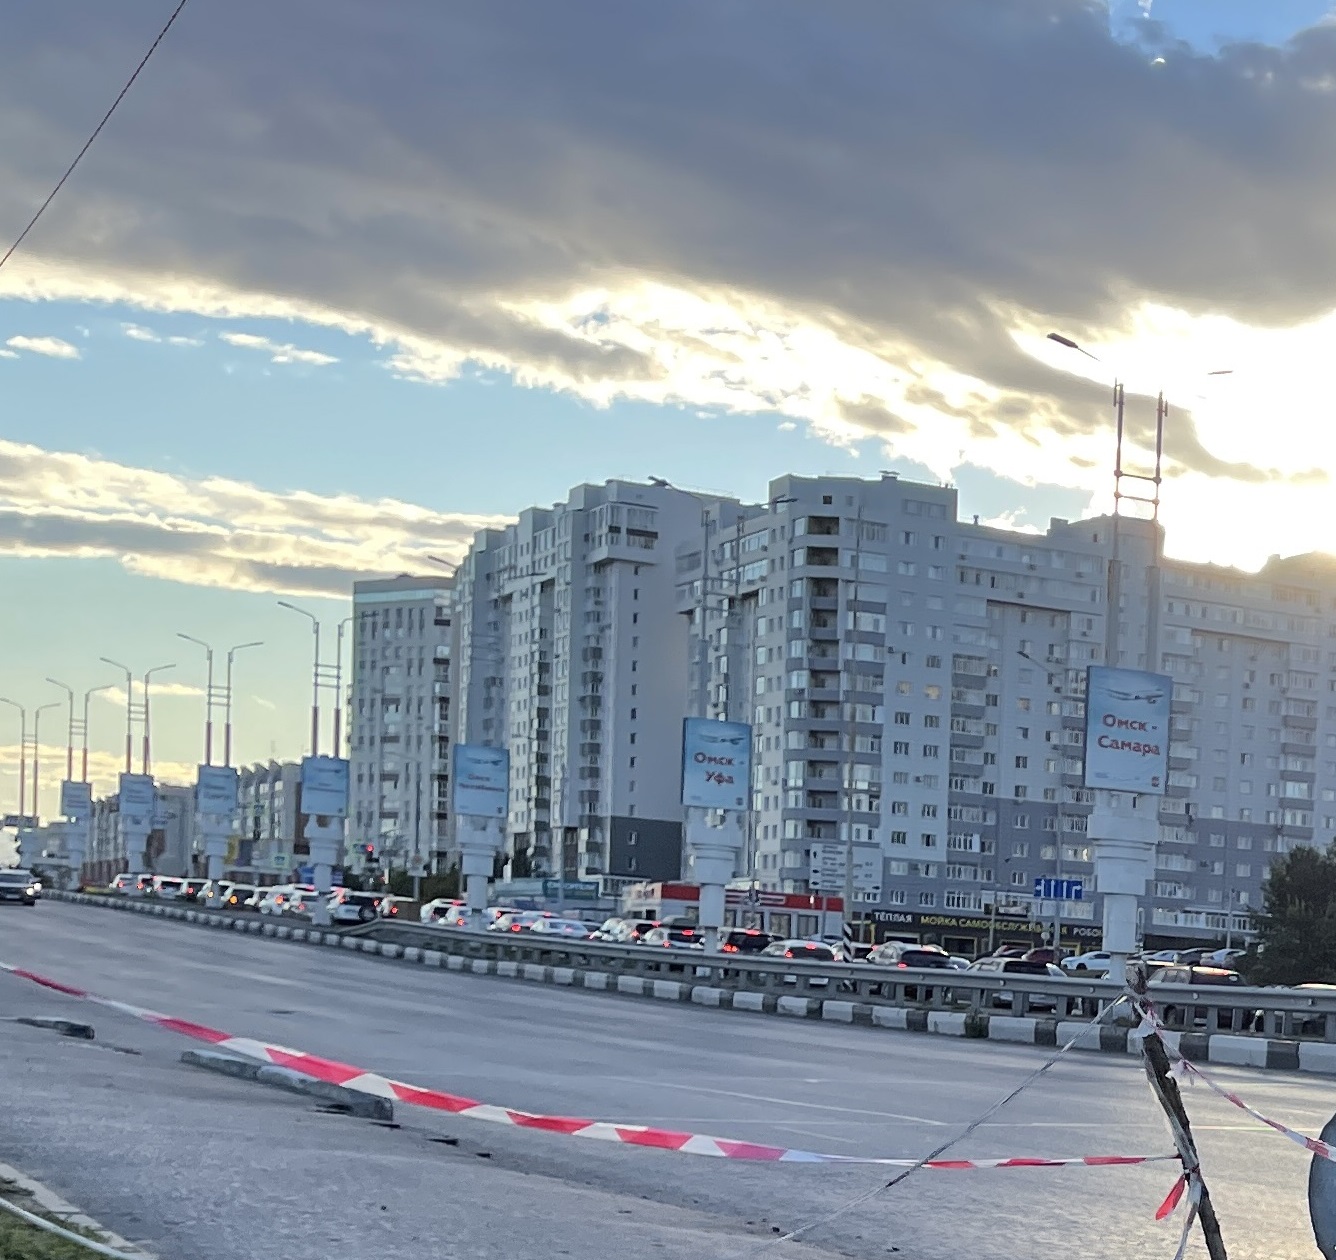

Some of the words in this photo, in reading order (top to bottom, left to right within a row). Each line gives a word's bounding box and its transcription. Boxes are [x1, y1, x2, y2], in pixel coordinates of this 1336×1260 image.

[1102, 714, 1148, 732] Омск
[1097, 735, 1161, 757] Самара
[694, 752, 734, 766] Омск
[704, 770, 735, 786] Уфа
[1073, 926, 1103, 938] РОБО
